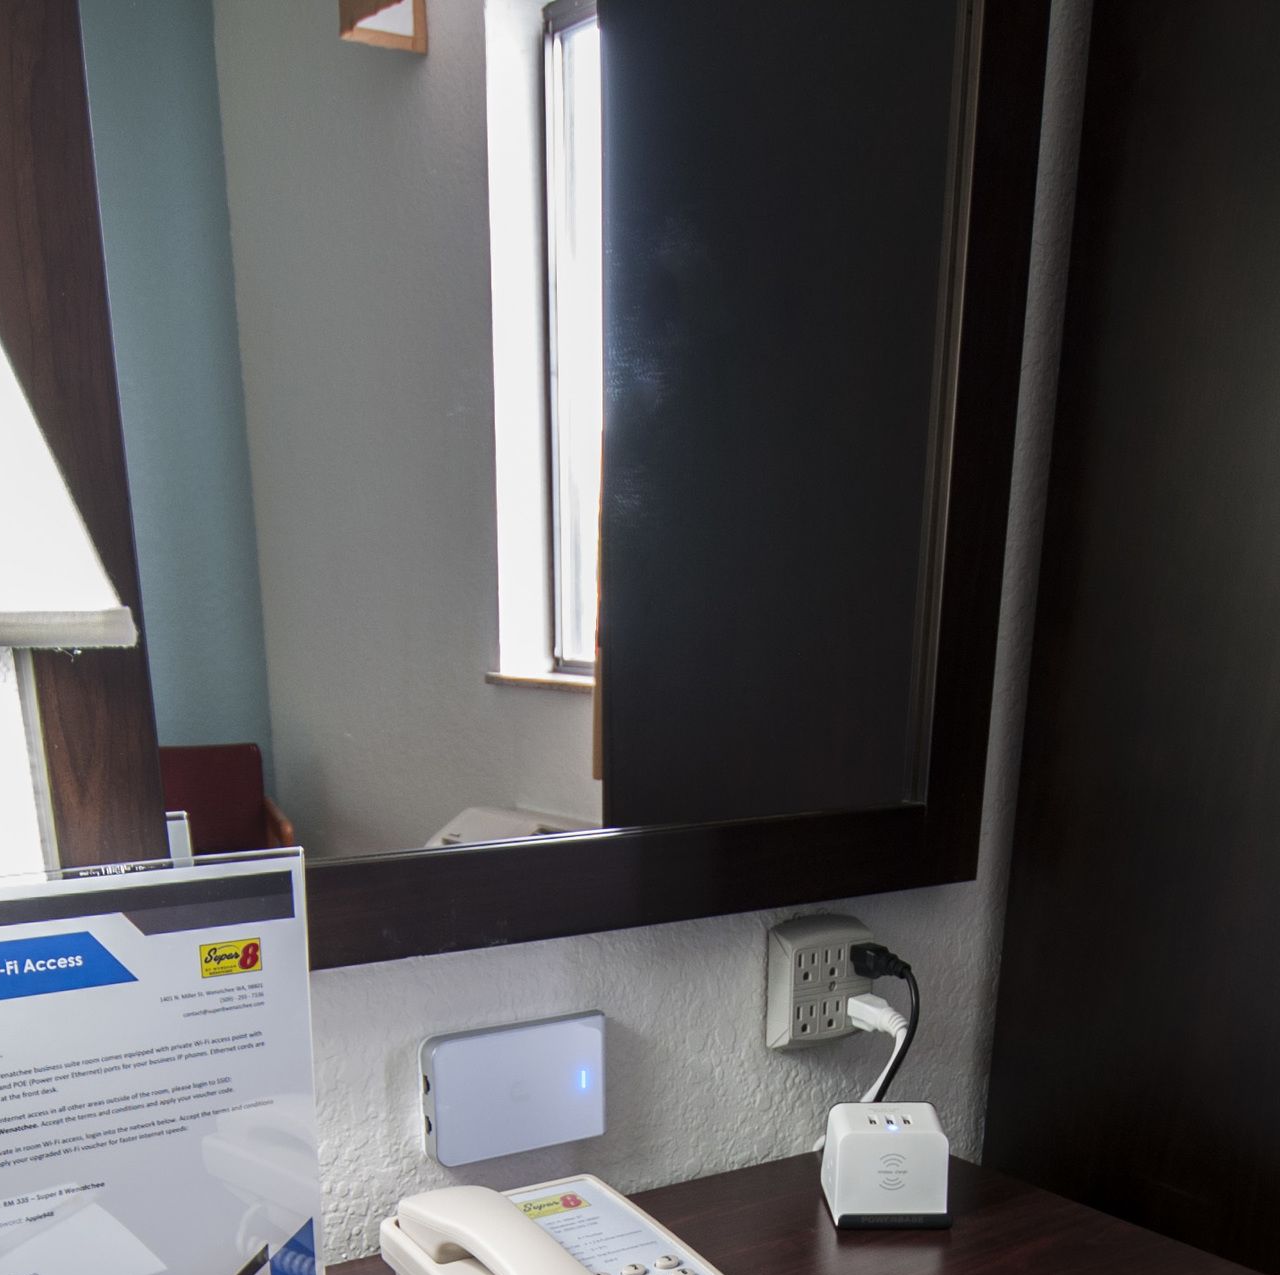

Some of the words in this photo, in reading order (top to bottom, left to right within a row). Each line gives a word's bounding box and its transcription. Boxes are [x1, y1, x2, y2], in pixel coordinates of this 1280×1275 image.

[23, 954, 83, 973] Access
[205, 948, 239, 965] Super
[238, 943, 259, 969] 8
[206, 987, 234, 996] Wenatchee
[34, 1064, 63, 1073] business
[101, 1054, 122, 1063] comes
[124, 1048, 154, 1059] equipped
[155, 1045, 169, 1053] with
[171, 1042, 192, 1051] private
[194, 1039, 210, 1047] Wi-Fi
[231, 1033, 248, 1042] point
[249, 1030, 262, 1038] with
[0, 1083, 11, 1091] and
[13, 1081, 26, 1089] POE
[29, 1077, 53, 1087] (Power
[54, 1074, 69, 1082] over
[71, 1067, 102, 1079] Ethernet)
[104, 1065, 121, 1074] ports
[133, 1061, 148, 1069] your
[149, 1055, 175, 1065] business
[210, 1045, 236, 1055] Ethernet
[9, 1093, 20, 1101] the
[22, 1090, 39, 1098] front
[41, 1118, 63, 1127] Accept
[65, 1115, 76, 1123] the
[111, 1103, 145, 1115] conditions
[159, 1097, 176, 1106] apply
[178, 1095, 191, 1103] your
[193, 1090, 217, 1099] voucher
[67, 1103, 85, 1112] other
[106, 1095, 130, 1105] outside
[171, 1084, 191, 1093] please
[193, 1081, 208, 1089] login
[42, 1139, 60, 1148] Wi-Fi
[85, 1132, 102, 1140] login
[130, 1122, 155, 1131] network
[180, 1113, 200, 1121] Accept
[244, 1099, 273, 1109] conditions
[30, 1151, 61, 1161] upgraded
[63, 1147, 80, 1155] Wi-Fi
[81, 1141, 107, 1150] voucher
[139, 1131, 164, 1139] internet
[36, 1192, 57, 1200] Super
[64, 1182, 105, 1194] Wenatchee
[523, 1200, 560, 1213] Super
[560, 1194, 582, 1208] 8
